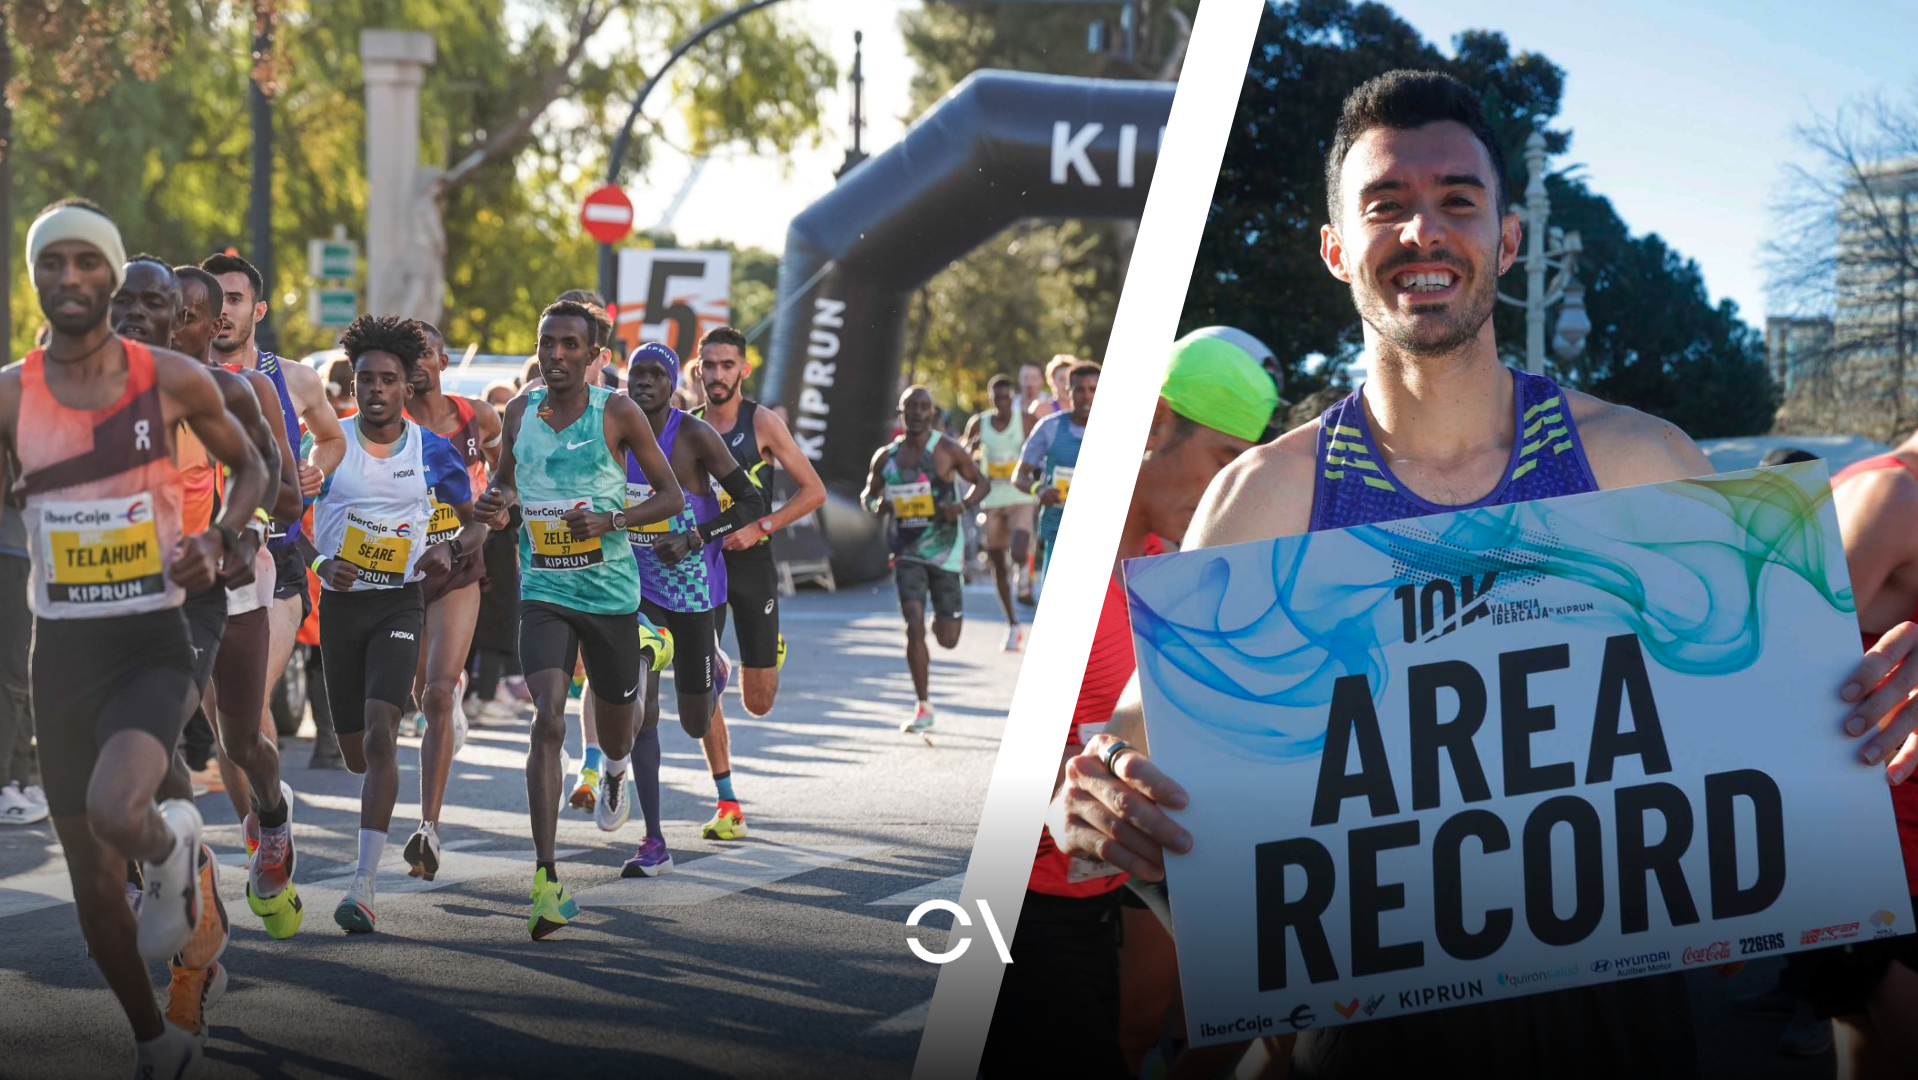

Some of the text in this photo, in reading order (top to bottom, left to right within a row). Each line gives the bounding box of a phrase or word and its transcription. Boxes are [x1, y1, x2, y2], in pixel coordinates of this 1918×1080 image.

[1050, 120, 1166, 188] KI
[643, 260, 706, 366] 5
[794, 297, 847, 461] KIPRUN
[393, 469, 415, 479] HOKA
[44, 508, 111, 526] iberCaja
[347, 512, 388, 534] iberCaja
[429, 507, 456, 522] STI
[524, 507, 564, 519] iberCaja
[65, 540, 148, 567] TELAHUM
[358, 543, 396, 562] SEARE
[562, 545, 571, 555] 37
[370, 560, 378, 569] 12
[544, 555, 589, 568] KIPRUN
[68, 580, 142, 601] KIPRUN
[1394, 571, 1500, 644] 10K
[1490, 599, 1539, 614] VALENCIA
[1492, 607, 1549, 626] IBERCAJA
[1556, 602, 1594, 615] KIPRUN
[390, 630, 415, 641] HOKA
[1310, 633, 1672, 826] AREA
[1255, 768, 1787, 992] RECORD
[1739, 932, 1785, 955] 226ERS
[1615, 951, 1670, 969] HYUNDAI
[1617, 963, 1672, 978] Autiber Motor
[1398, 980, 1484, 1009] KIPRUN
[1199, 1014, 1273, 1038] iberCaja
